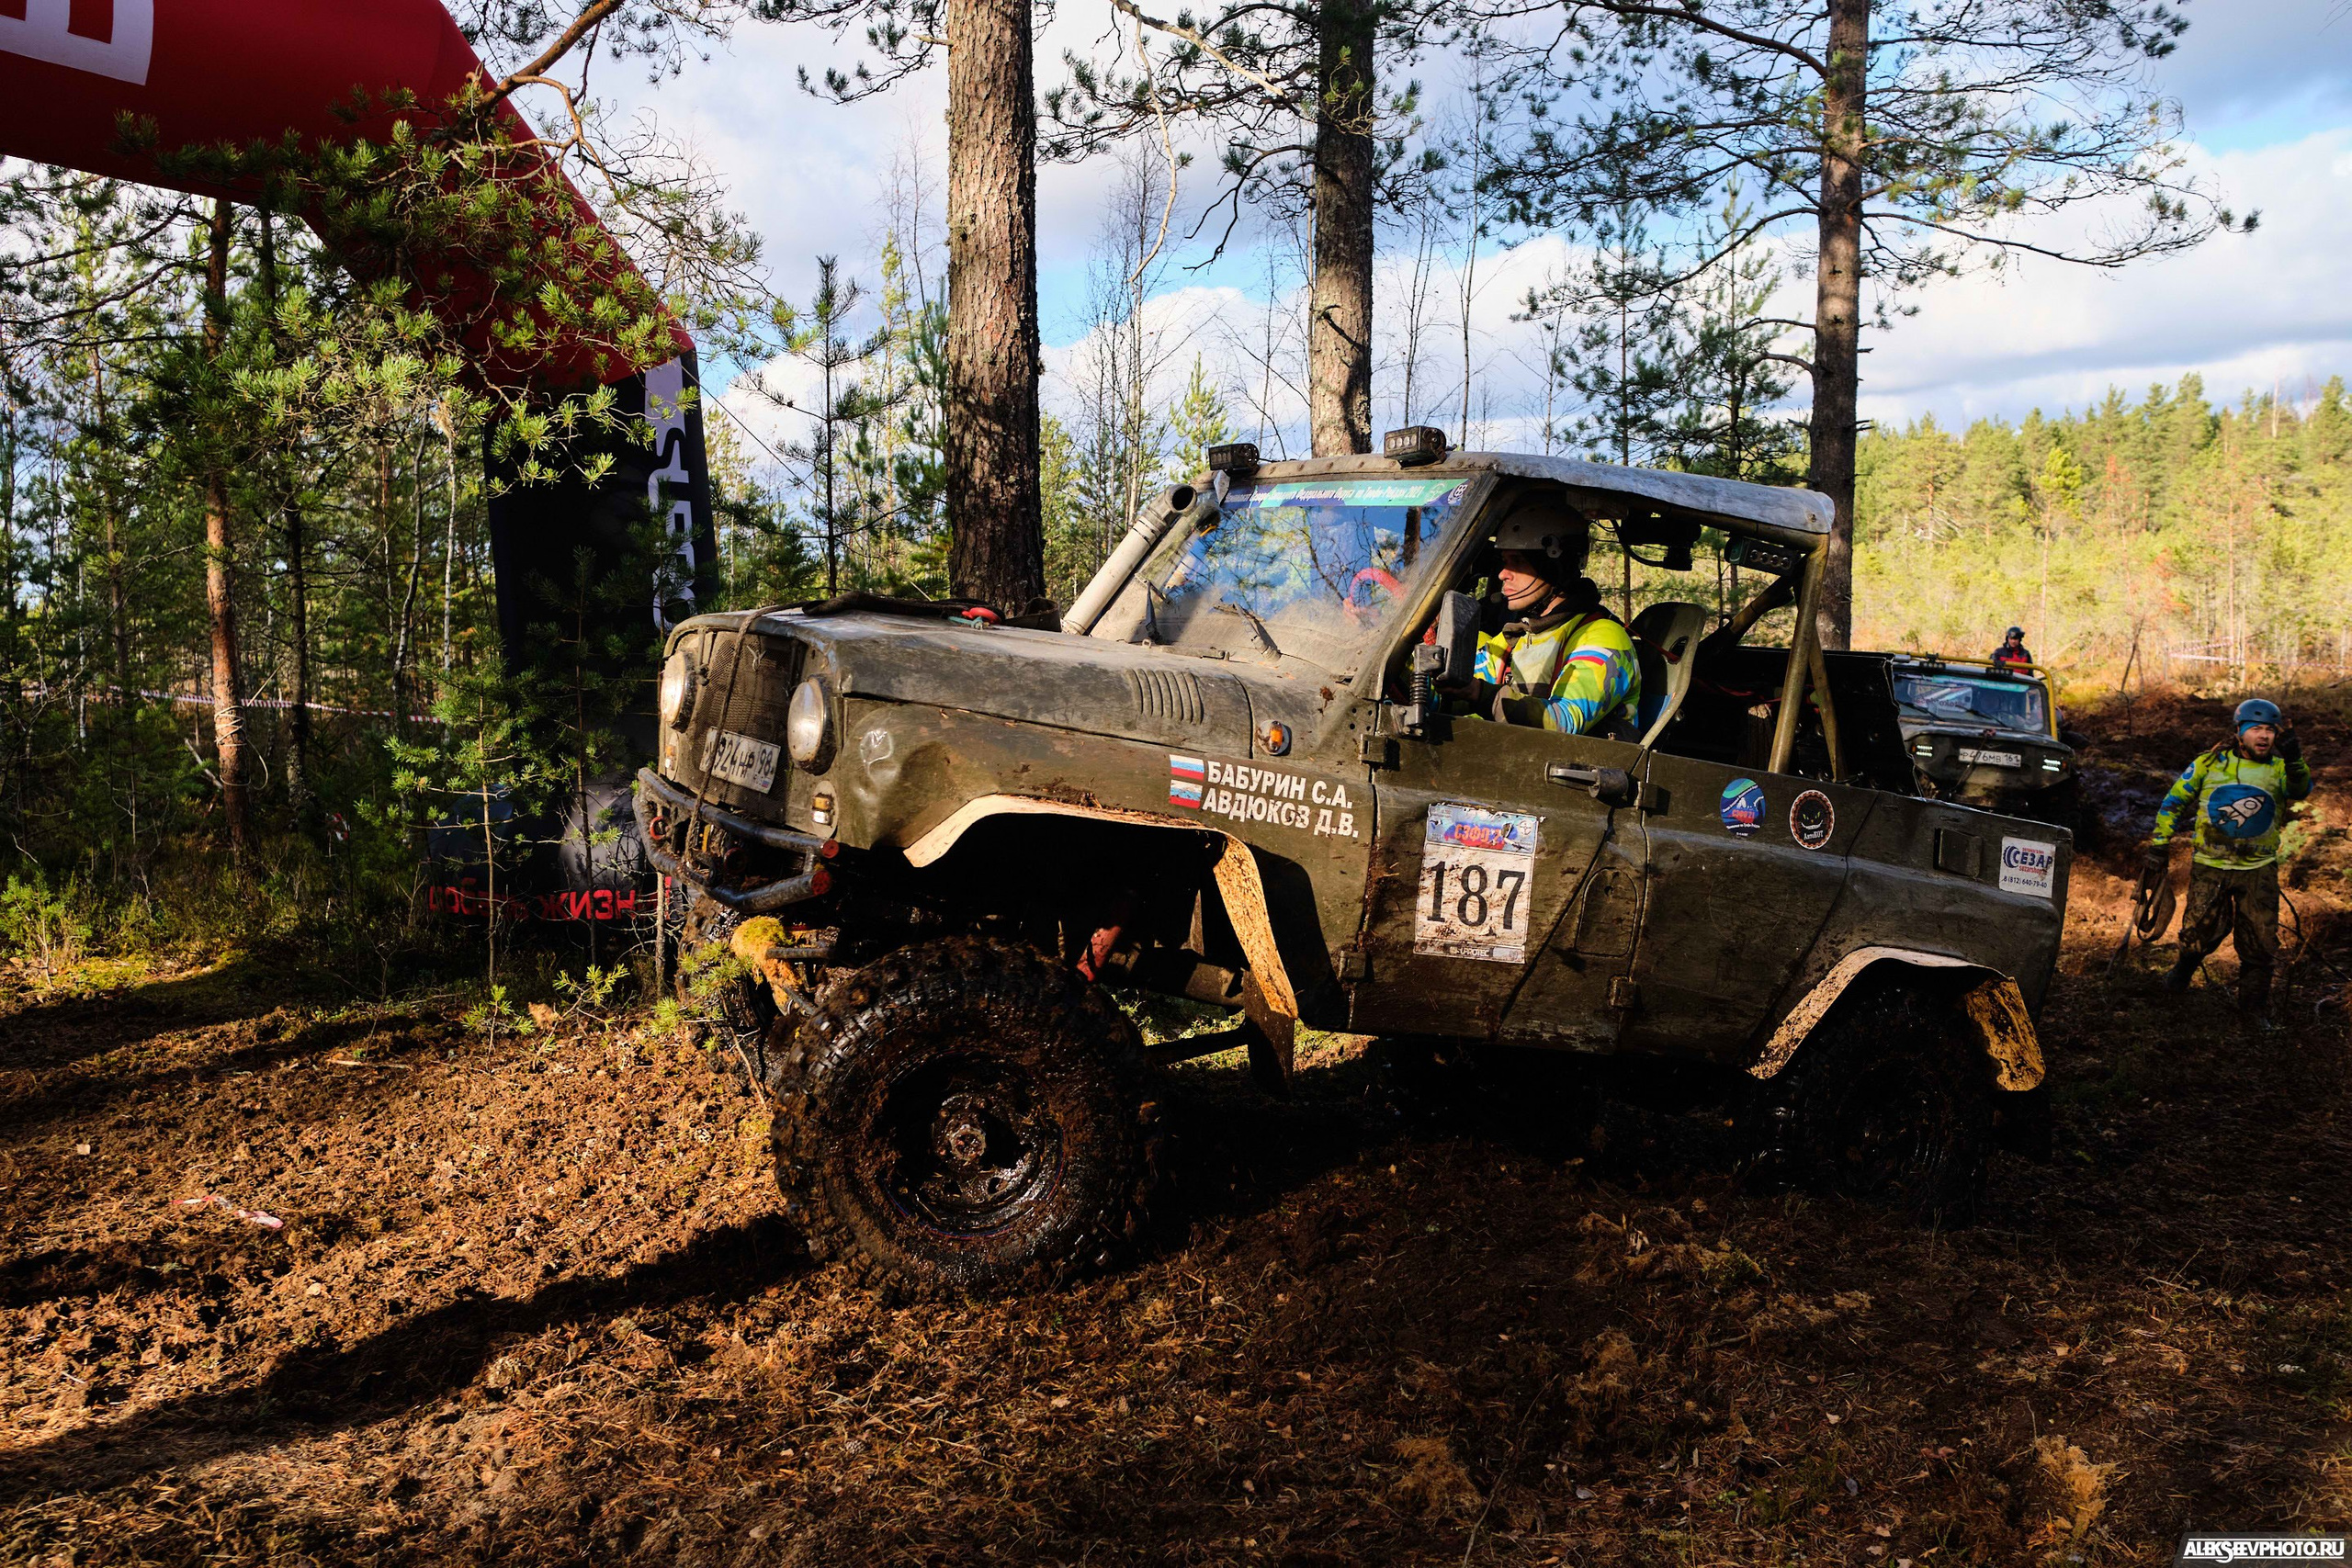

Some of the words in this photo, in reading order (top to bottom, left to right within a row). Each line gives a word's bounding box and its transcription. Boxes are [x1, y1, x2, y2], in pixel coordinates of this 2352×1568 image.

[1207, 761, 1306, 801] БАБУРИН
[1311, 780, 1353, 809] С.А.
[1202, 787, 1311, 829] АВДЮКОВ
[1313, 808, 1360, 838] Д.В.
[1454, 824, 1490, 843] СЗФО
[2013, 850, 2053, 869] СЕЗАР
[1427, 861, 1526, 930] 187
